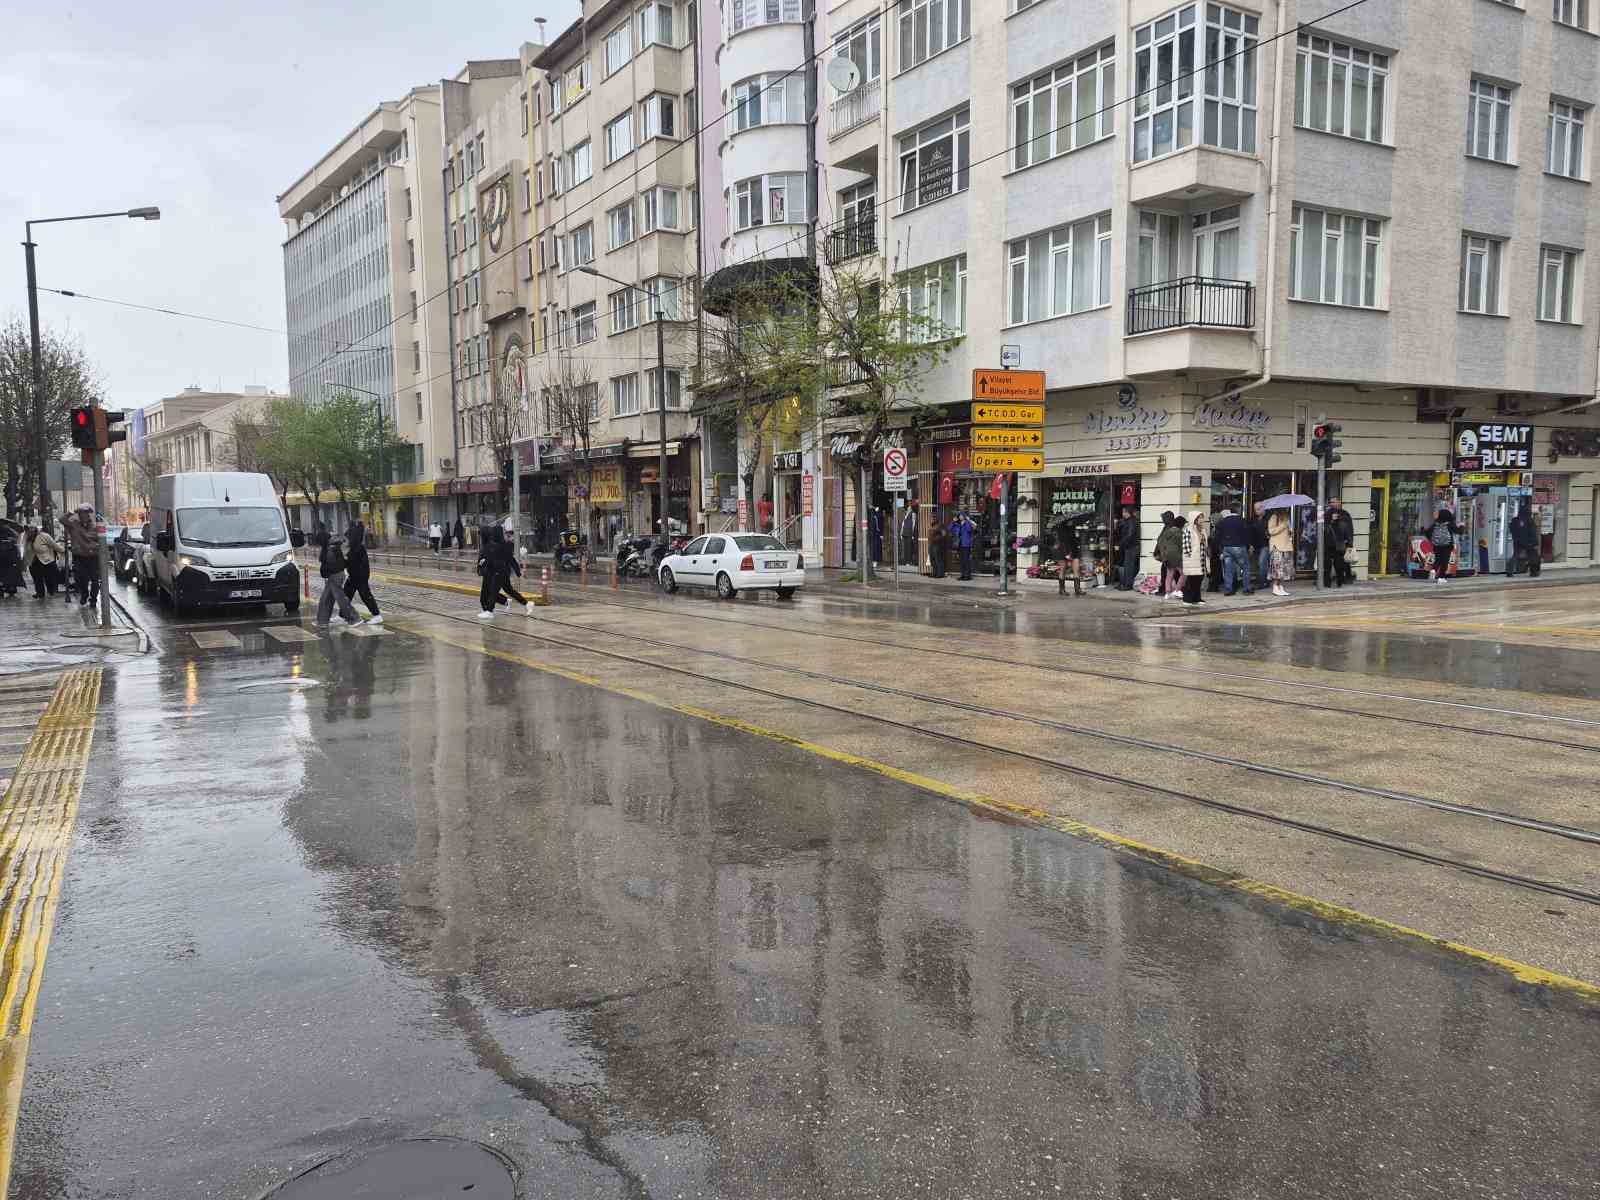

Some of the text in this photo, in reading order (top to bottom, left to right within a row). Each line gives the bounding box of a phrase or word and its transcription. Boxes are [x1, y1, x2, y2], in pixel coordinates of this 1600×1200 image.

[1020, 410, 1035, 418] Gar
[977, 433, 1028, 443] Kentpark
[1479, 425, 1530, 443] SEMT
[1481, 444, 1529, 467] BÜFE
[976, 456, 1013, 466] Opera
